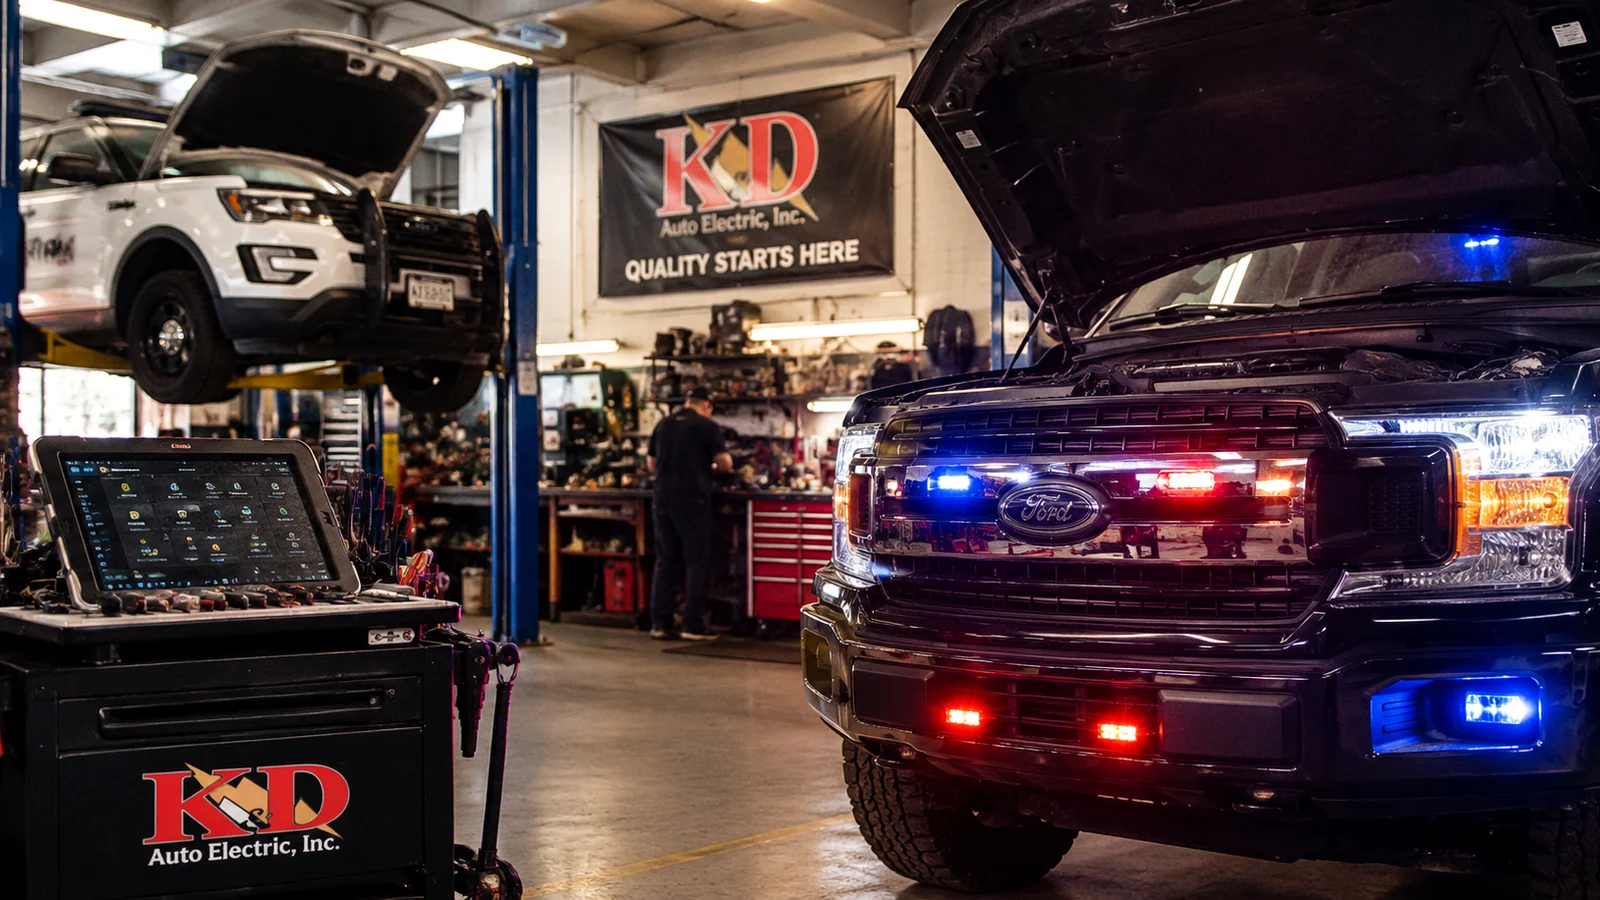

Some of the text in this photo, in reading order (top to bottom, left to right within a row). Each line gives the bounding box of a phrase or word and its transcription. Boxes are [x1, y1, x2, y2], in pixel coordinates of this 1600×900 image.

[659, 206, 806, 238] Auto Electric, Inc.
[625, 239, 860, 283] QUALITY STARTS HERE
[1021, 494, 1073, 521] Ford
[147, 834, 341, 866] Auto Electric, Inc.
